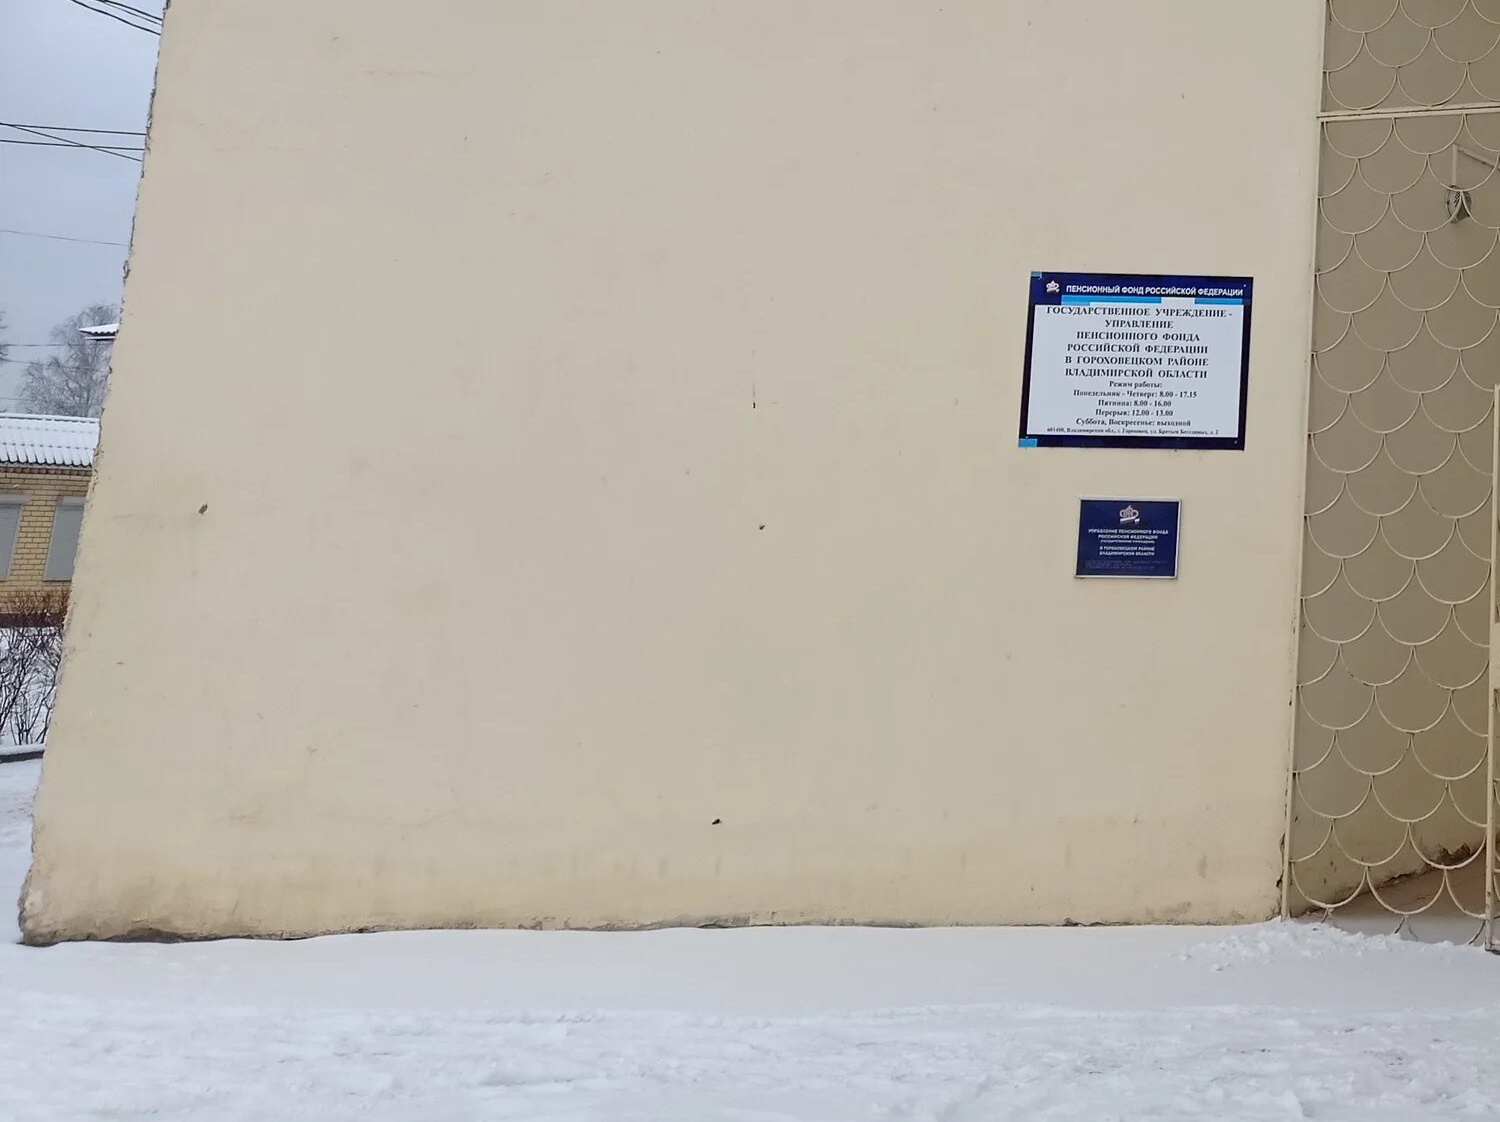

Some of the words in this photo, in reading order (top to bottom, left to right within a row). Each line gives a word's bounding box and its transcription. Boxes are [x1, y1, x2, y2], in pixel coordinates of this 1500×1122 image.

[1066, 284, 1120, 294] ПЕНСИОННЫЙ
[1121, 286, 1144, 295] ФОНД
[1145, 286, 1196, 295] РОССИЙСКОЙ
[1197, 288, 1243, 296] ФЕДЕРАЦИИ
[1047, 306, 1150, 317] ГОСУДАРСТВЕННОЕ
[1155, 308, 1227, 318] УЧРЕЖДЕНИЕ
[1105, 320, 1174, 329] УПРАВЛЕНИЕ
[1076, 331, 1158, 341] ПЕНСИОННОГО
[1162, 332, 1200, 342] ФОНДА
[1067, 342, 1140, 353] РОССИЙСКОЙ
[1145, 345, 1208, 355] ФЕДЕРАЦИИ
[1065, 356, 1072, 364] В
[1077, 356, 1163, 366] ГОРОХОВЕЦКОМ
[1168, 356, 1209, 367] РАЙОНЕ
[1065, 367, 1153, 378] ВЛАДИМИРСКОЙ
[1158, 369, 1208, 379] ОБЛАСТИ
[1134, 381, 1163, 389] работы:
[1073, 389, 1120, 397] Понедельник
[1127, 390, 1158, 399] Четверг:
[1098, 399, 1132, 407] Пятница:
[1095, 409, 1130, 417] Перерыв:
[1076, 418, 1107, 426] Суббота,
[1157, 419, 1191, 427] выходной
